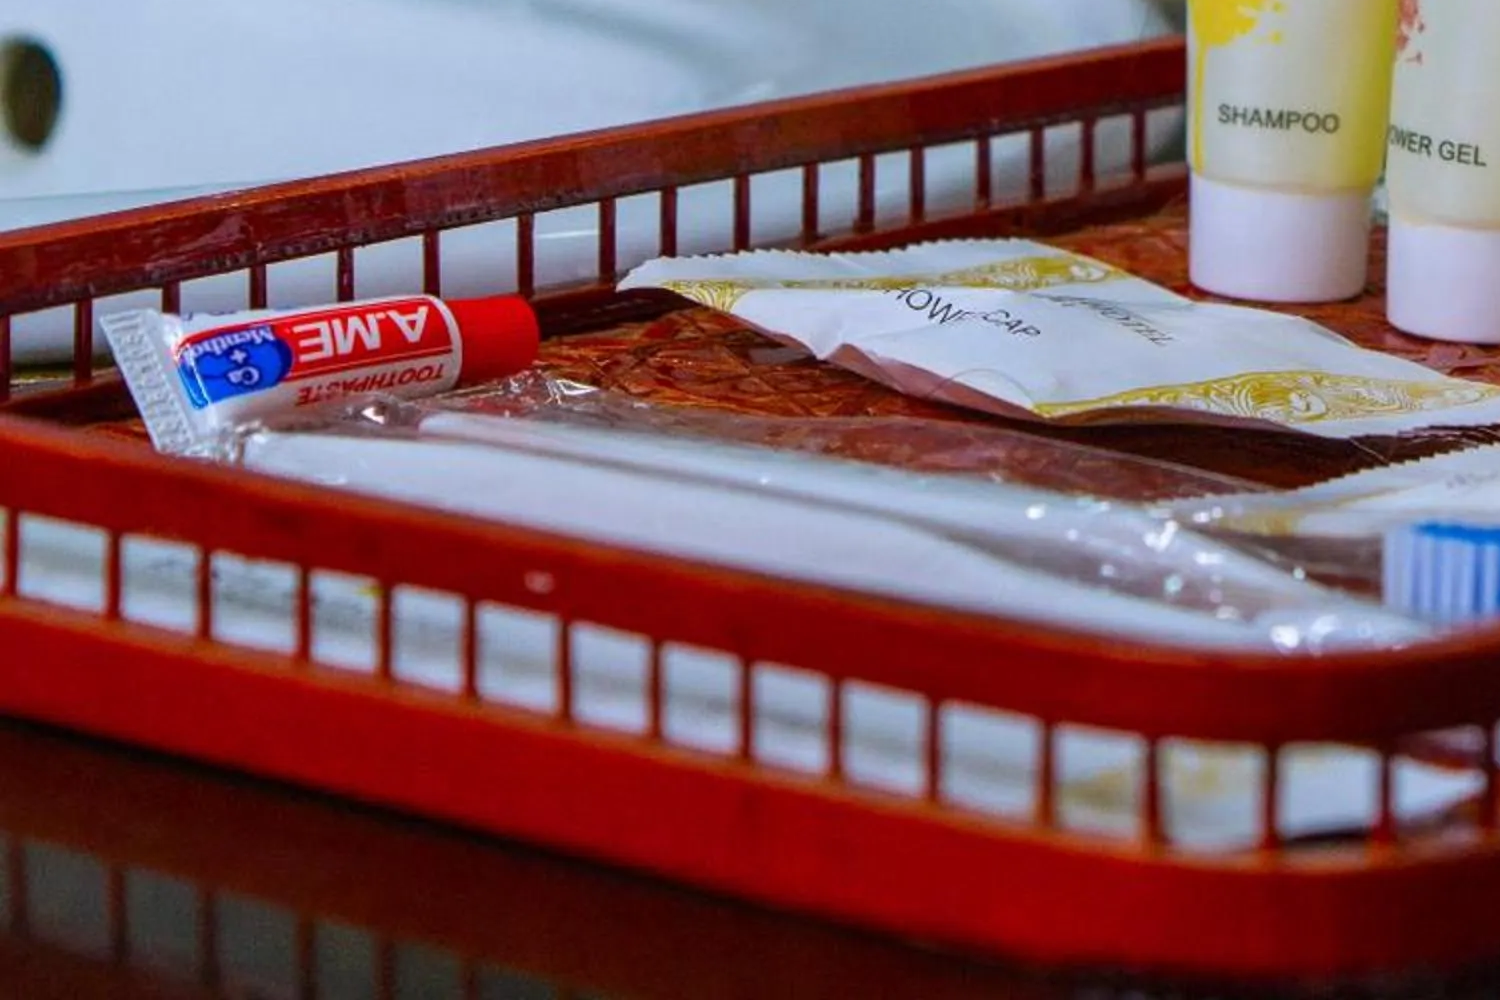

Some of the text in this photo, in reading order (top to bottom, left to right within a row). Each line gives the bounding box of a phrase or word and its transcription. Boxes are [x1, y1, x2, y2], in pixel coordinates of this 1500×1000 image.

[1217, 103, 1341, 135] SHAMPOO
[1438, 139, 1487, 168] GEL
[983, 309, 1041, 337] CAP
[227, 366, 260, 386] Ca
[295, 362, 445, 407] TOOTHPASTE
